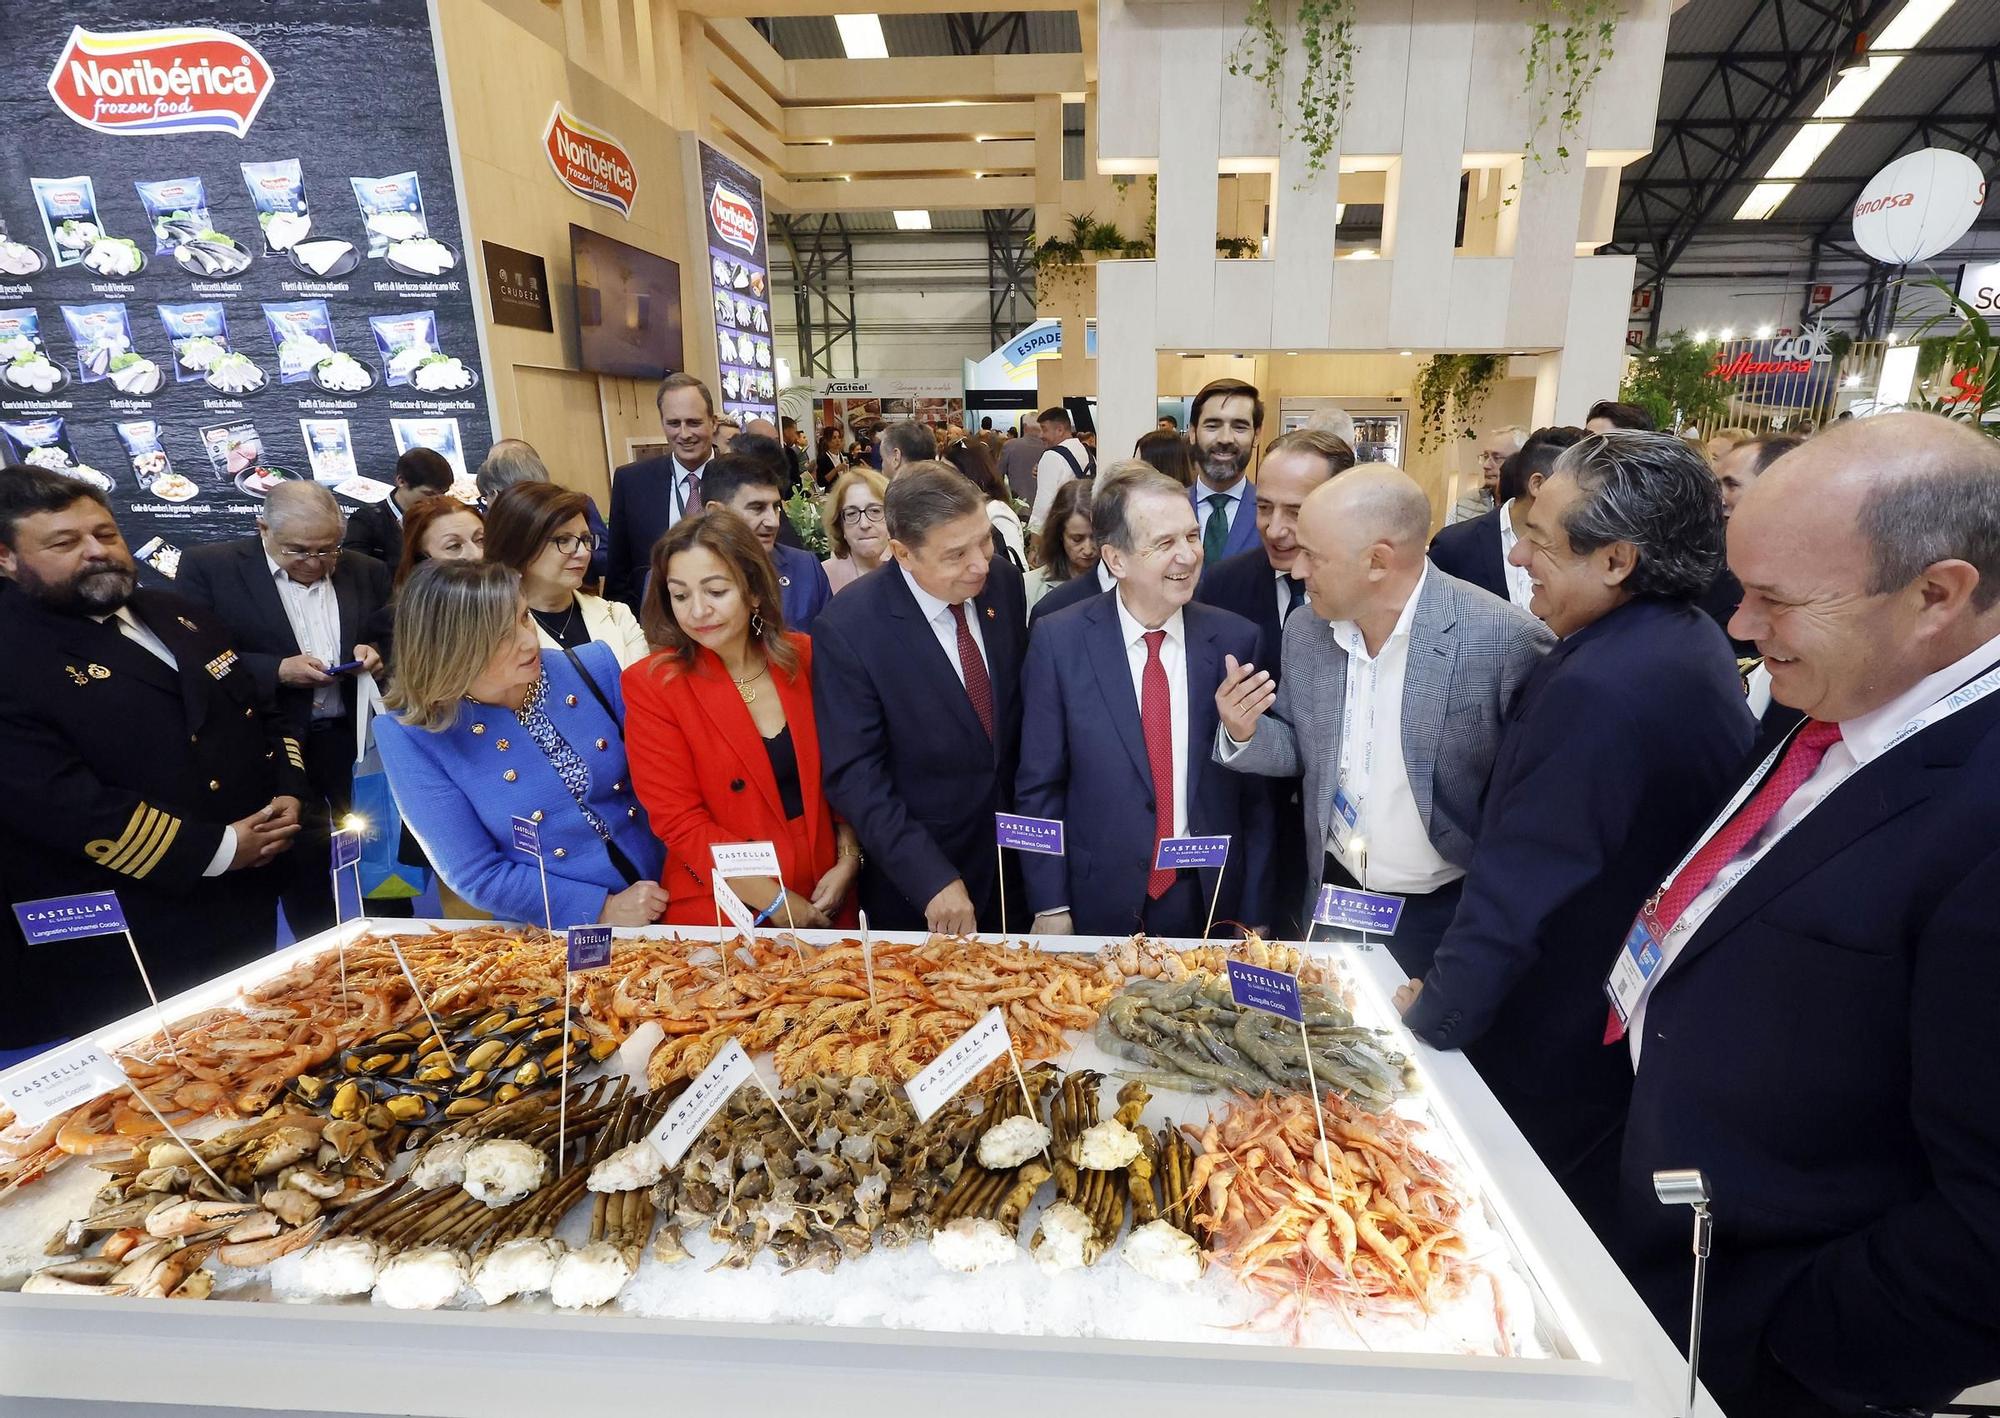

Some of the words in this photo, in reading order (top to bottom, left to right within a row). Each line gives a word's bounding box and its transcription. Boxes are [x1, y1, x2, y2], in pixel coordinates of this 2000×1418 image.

[70, 58, 256, 97] Noribérica
[90, 98, 151, 122] frozen
[152, 97, 193, 121] food
[556, 126, 633, 192] Noribérica
[564, 162, 592, 184] frozen
[592, 176, 609, 193] food
[281, 282, 297, 291] Filetti
[303, 282, 326, 291] Merluzzo
[373, 282, 389, 291] Filetti
[395, 282, 417, 291] Merluzzo
[449, 282, 460, 291] MSC
[501, 286, 539, 301] CRUDEZA
[825, 383, 869, 395] Kasteel
[110, 400, 125, 409] Filetti
[203, 400, 219, 408] Filetti
[318, 400, 334, 409] Totano
[334, 400, 357, 409] Atlantico
[420, 400, 437, 409] Totano
[456, 400, 476, 409] Pacifico
[1000, 822, 1056, 836] CASTELLAR
[1164, 844, 1224, 852] CASTELLAR
[26, 903, 112, 921] CASTELLAR
[32, 927, 68, 938] Langostino
[99, 921, 120, 929] Cocido
[1373, 921, 1389, 929] Crudo
[574, 935, 609, 945] CASTELLAR
[1233, 970, 1292, 993] CASTELLAR
[1248, 994, 1270, 1006] Quisquilla
[919, 1023, 999, 1092] CASTELLAR
[12, 1054, 98, 1098] CASTELLAR
[661, 1052, 739, 1141] CASTELLAR
